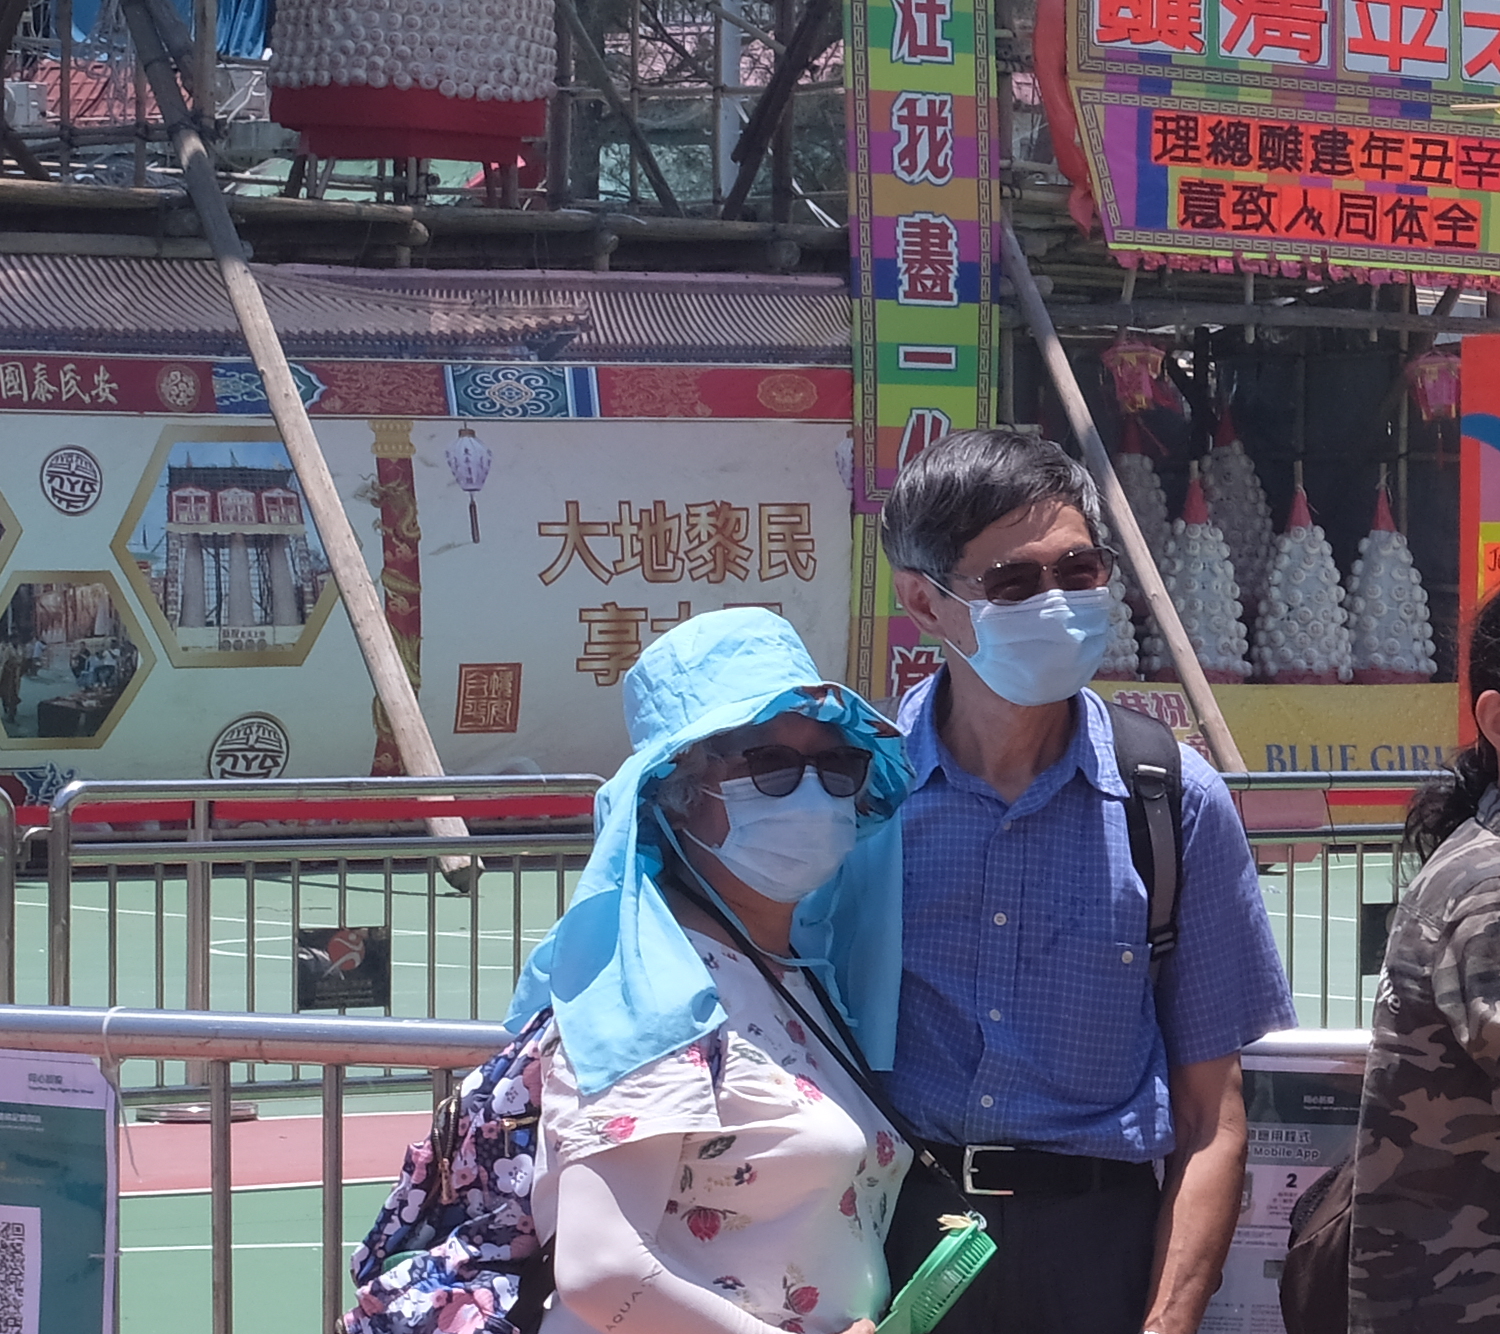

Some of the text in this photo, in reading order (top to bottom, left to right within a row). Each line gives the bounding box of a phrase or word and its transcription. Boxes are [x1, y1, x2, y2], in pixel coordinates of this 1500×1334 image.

[537, 500, 819, 588] 大地黎民
[1265, 743, 1357, 772] BLUE
[1254, 1146, 1320, 1161] Mobile App
[1285, 1173, 1297, 1188] 2
